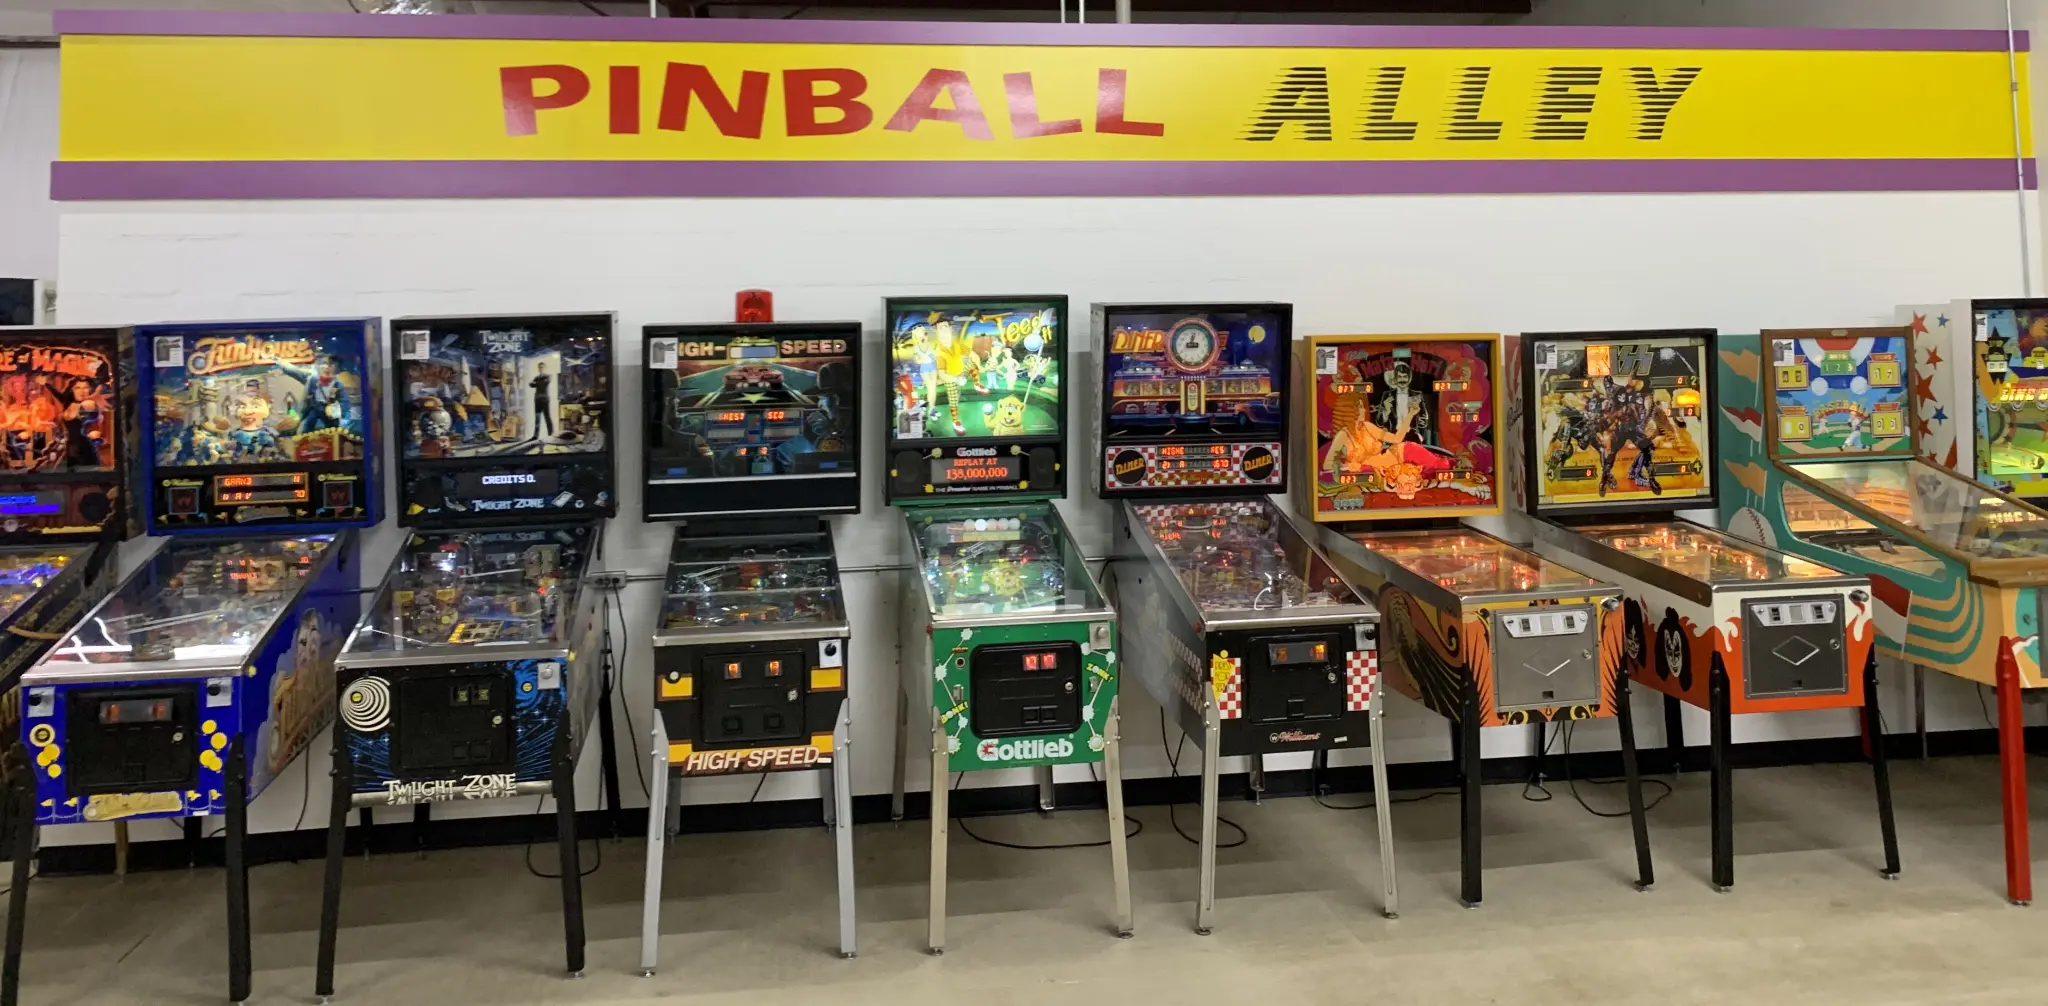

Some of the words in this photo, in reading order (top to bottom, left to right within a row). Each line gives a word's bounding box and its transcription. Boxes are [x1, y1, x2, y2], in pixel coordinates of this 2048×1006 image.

[499, 61, 1165, 140] PINBALL
[1235, 66, 1704, 141] ALLEY
[478, 329, 531, 345] TWILIGHT
[486, 341, 523, 353] ZONE
[678, 341, 726, 357] IGH-
[780, 339, 847, 355] SPEED
[956, 446, 996, 457] Gottlieb
[1116, 458, 1145, 475] DINER
[1244, 454, 1273, 471] DINER
[482, 474, 526, 485] CREDITS
[471, 499, 512, 512] TWILIGHT
[513, 498, 545, 509] ZONE
[687, 751, 741, 771] HIGH
[747, 746, 820, 768] SPEED
[977, 738, 1074, 762] Gottlieb
[382, 779, 457, 801] TWILIGHT
[461, 773, 517, 793] ZONE
